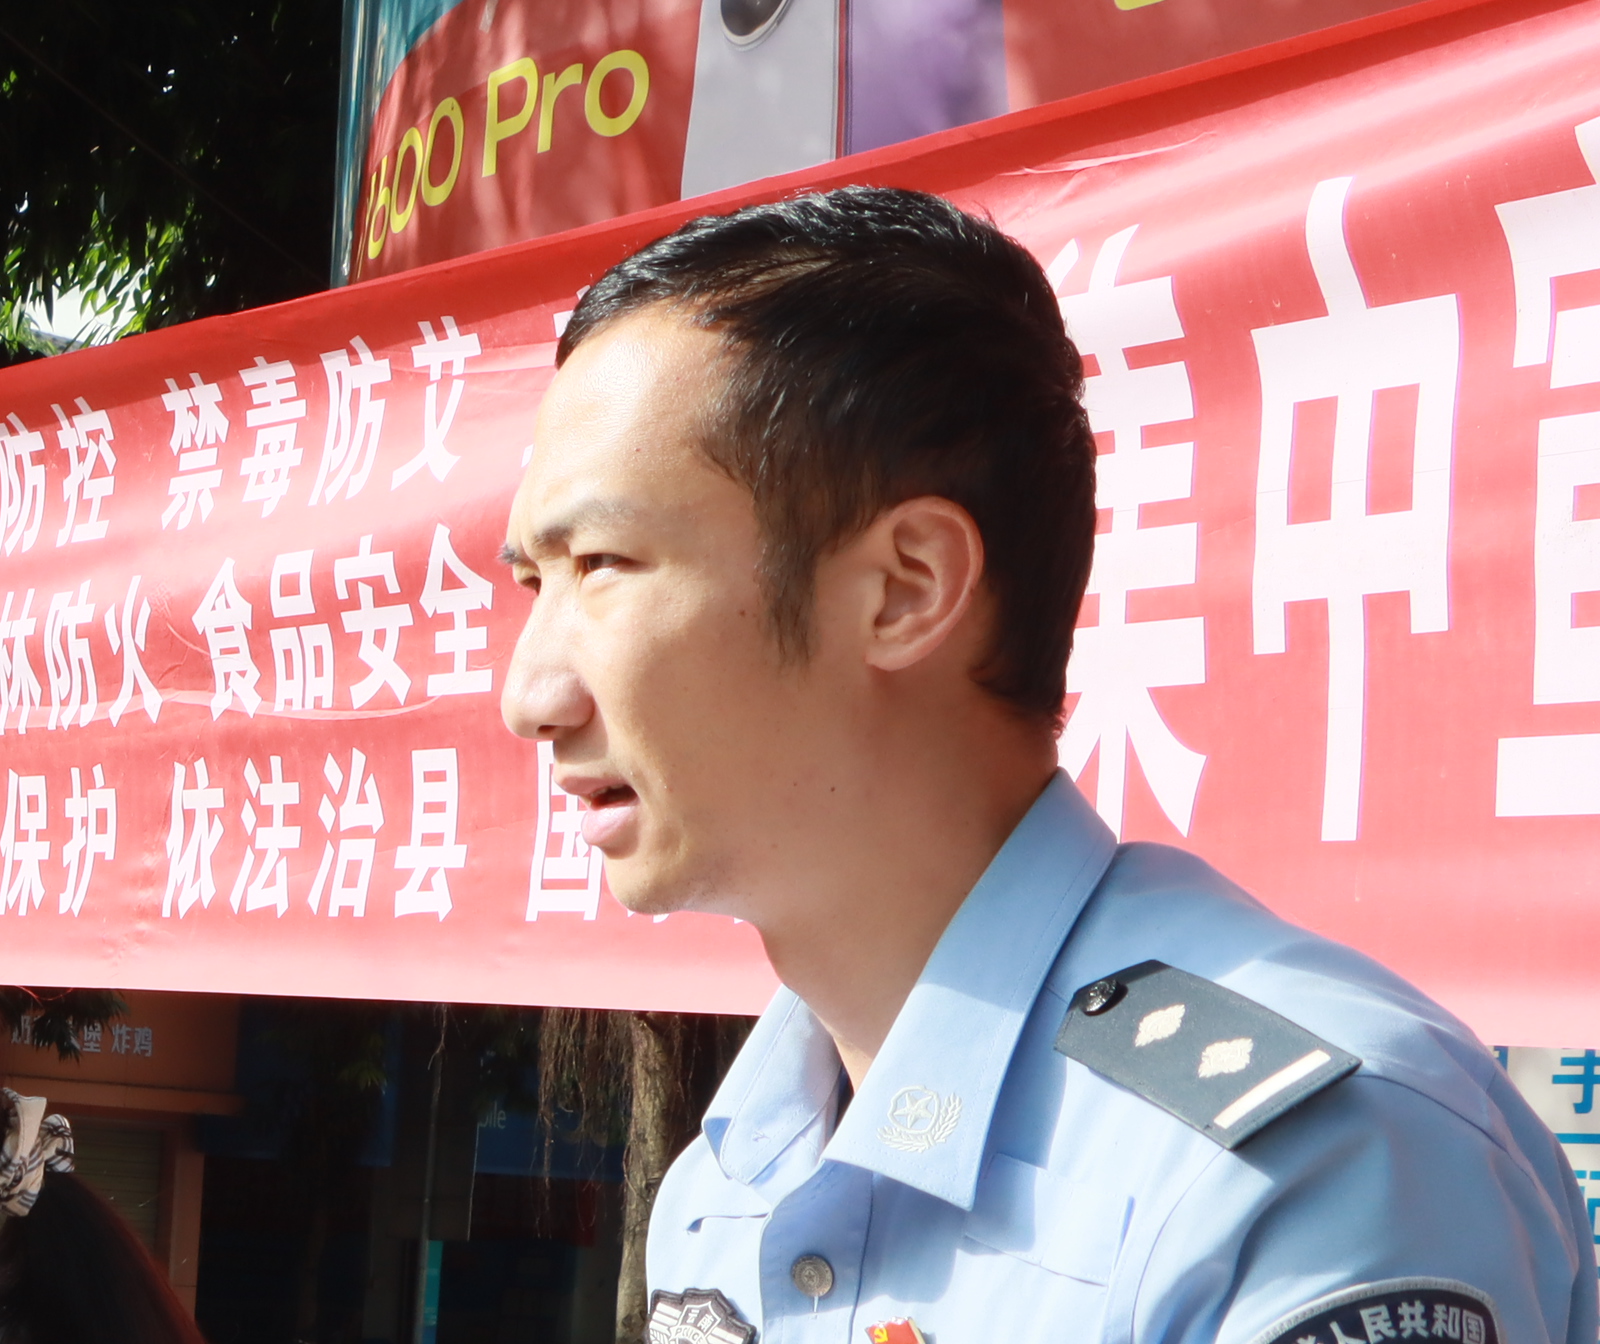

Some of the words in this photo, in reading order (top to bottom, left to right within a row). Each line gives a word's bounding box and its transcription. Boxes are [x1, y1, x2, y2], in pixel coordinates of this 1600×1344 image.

[481, 49, 650, 178] Pro
[161, 315, 483, 531] 禁毒防艾
[191, 523, 495, 723] 食品安全
[161, 746, 468, 923] 依法治县
